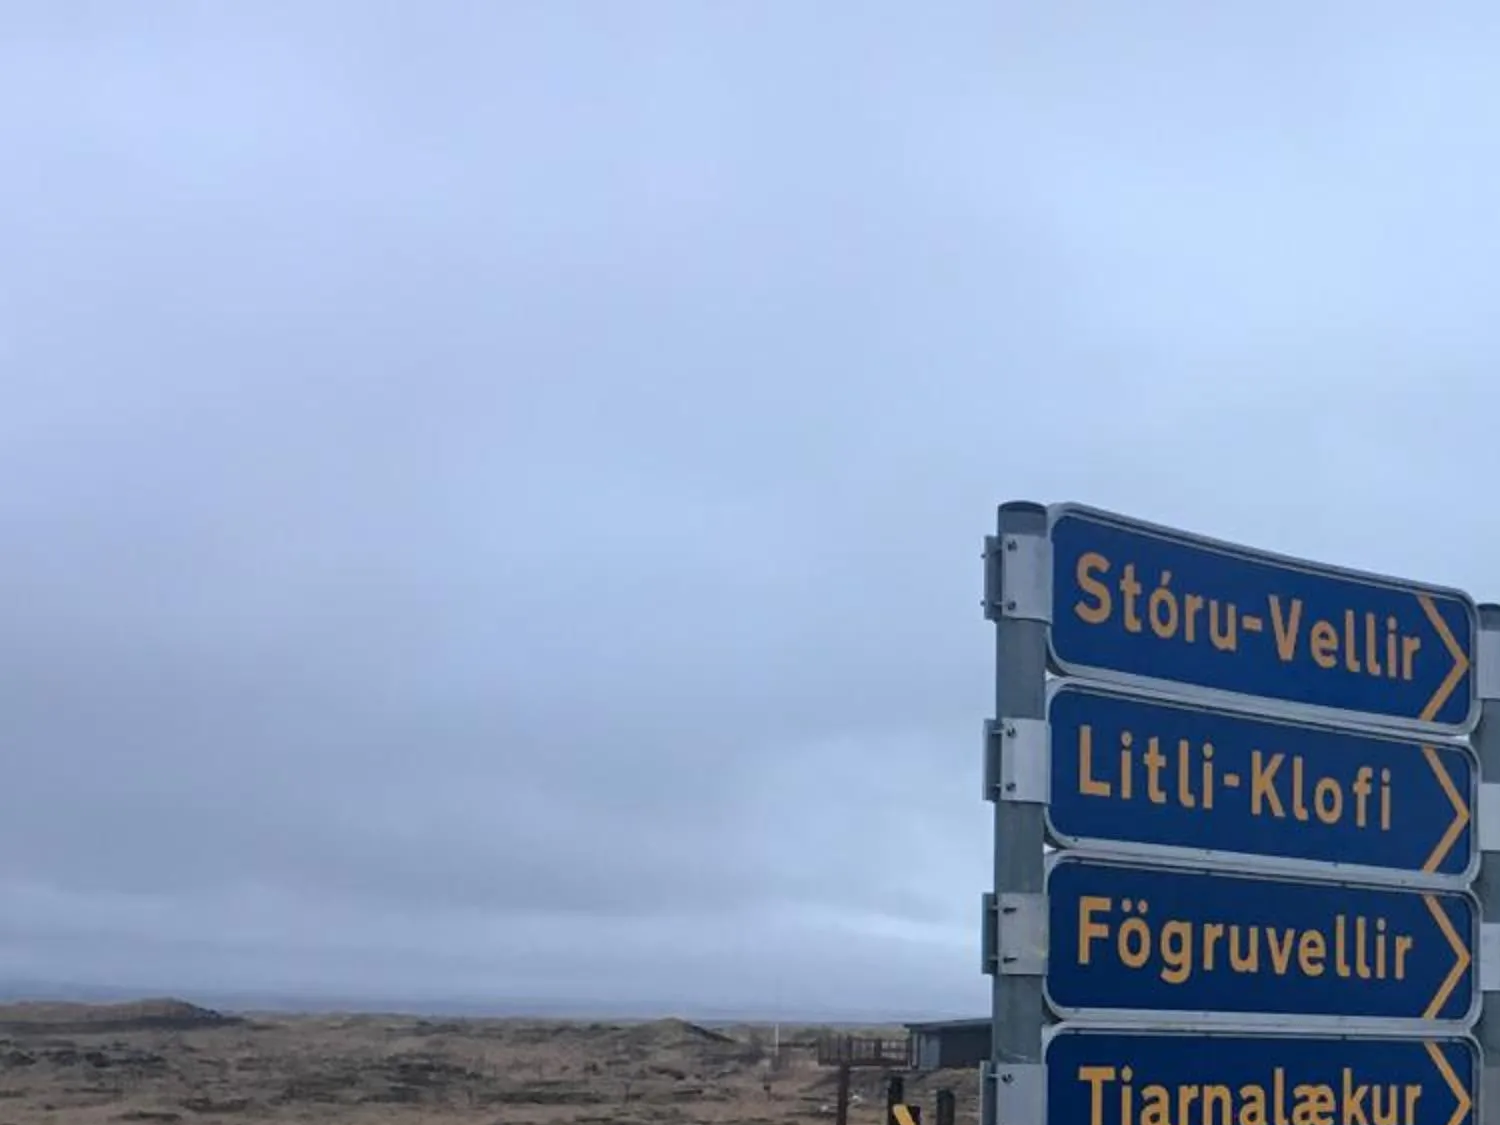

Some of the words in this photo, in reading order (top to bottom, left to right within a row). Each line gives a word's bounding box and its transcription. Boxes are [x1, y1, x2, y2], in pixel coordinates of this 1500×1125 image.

[1074, 552, 1421, 680] Stóru-Vellir
[1078, 724, 1391, 830] Litli-Klofi
[1077, 896, 1413, 984] Fögruvellir
